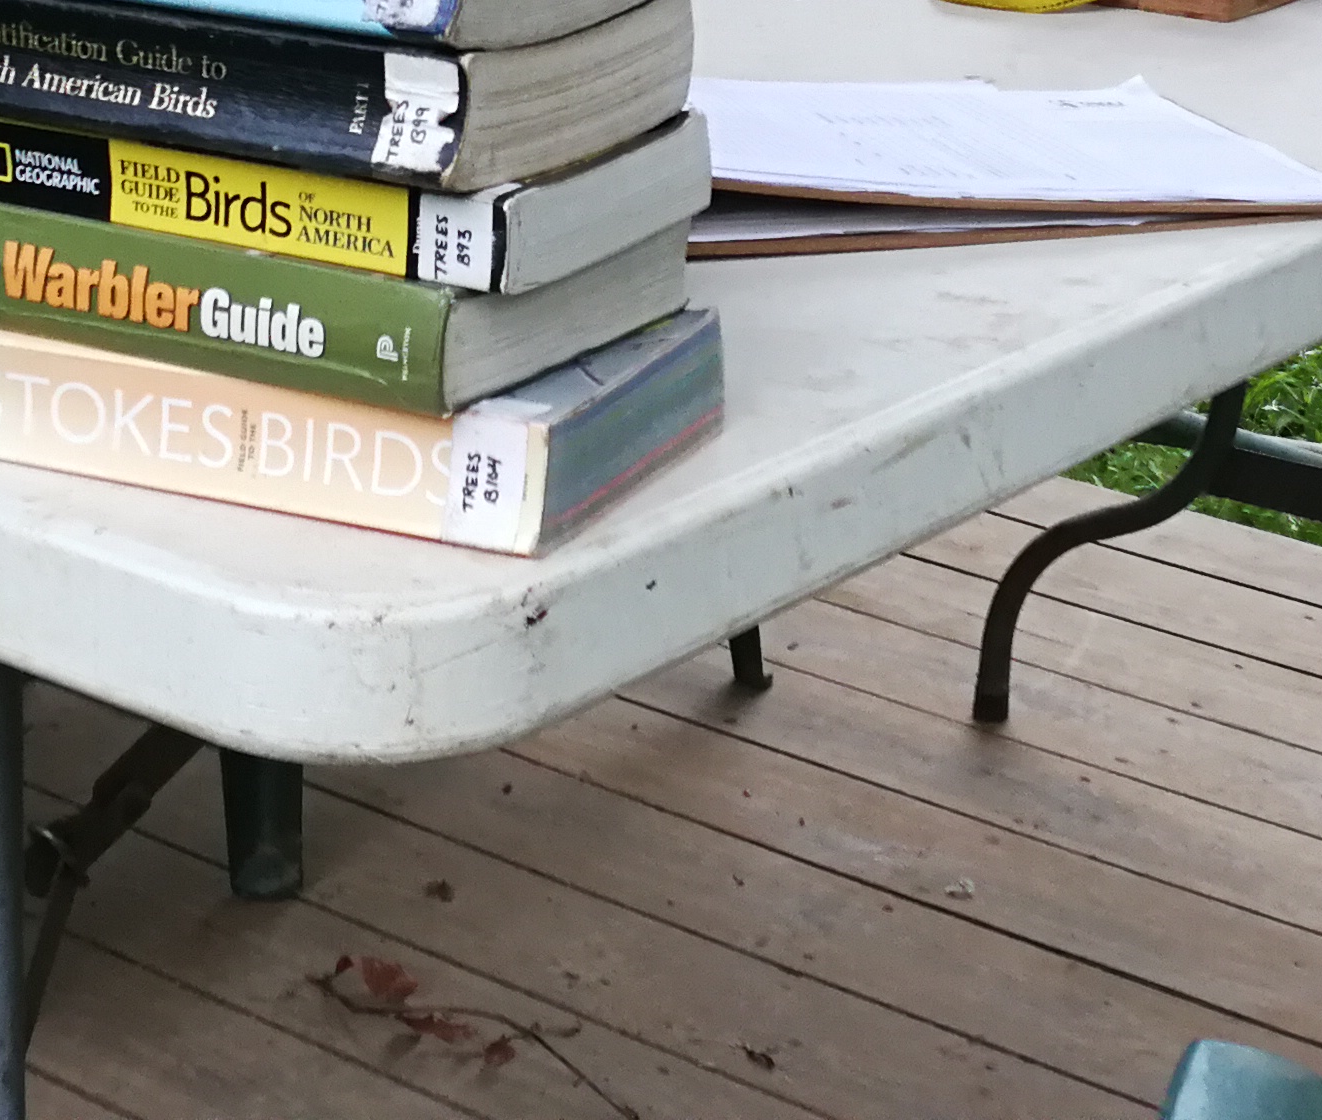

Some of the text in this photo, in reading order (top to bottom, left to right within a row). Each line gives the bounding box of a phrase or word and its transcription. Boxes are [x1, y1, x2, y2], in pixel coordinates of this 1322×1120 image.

[116, 38, 193, 76] Guide
[200, 54, 227, 81] to
[21, 62, 143, 107] American
[148, 81, 218, 120] Birds
[348, 91, 369, 135] PART
[385, 100, 410, 162] TREES
[14, 148, 83, 175] NATIONAL
[15, 164, 101, 196] GEOGRAPHIC
[118, 158, 182, 184] FIELD
[120, 179, 181, 204] GUIDE
[132, 199, 179, 220] TO THE
[184, 170, 293, 239] Birds
[297, 191, 316, 204] OF
[298, 204, 373, 234] NORTH
[295, 225, 396, 259] AMERICA
[434, 213, 449, 280] TREES
[3, 240, 200, 332] Warbler
[199, 286, 326, 359] Guide
[461, 449, 482, 514] TREES
